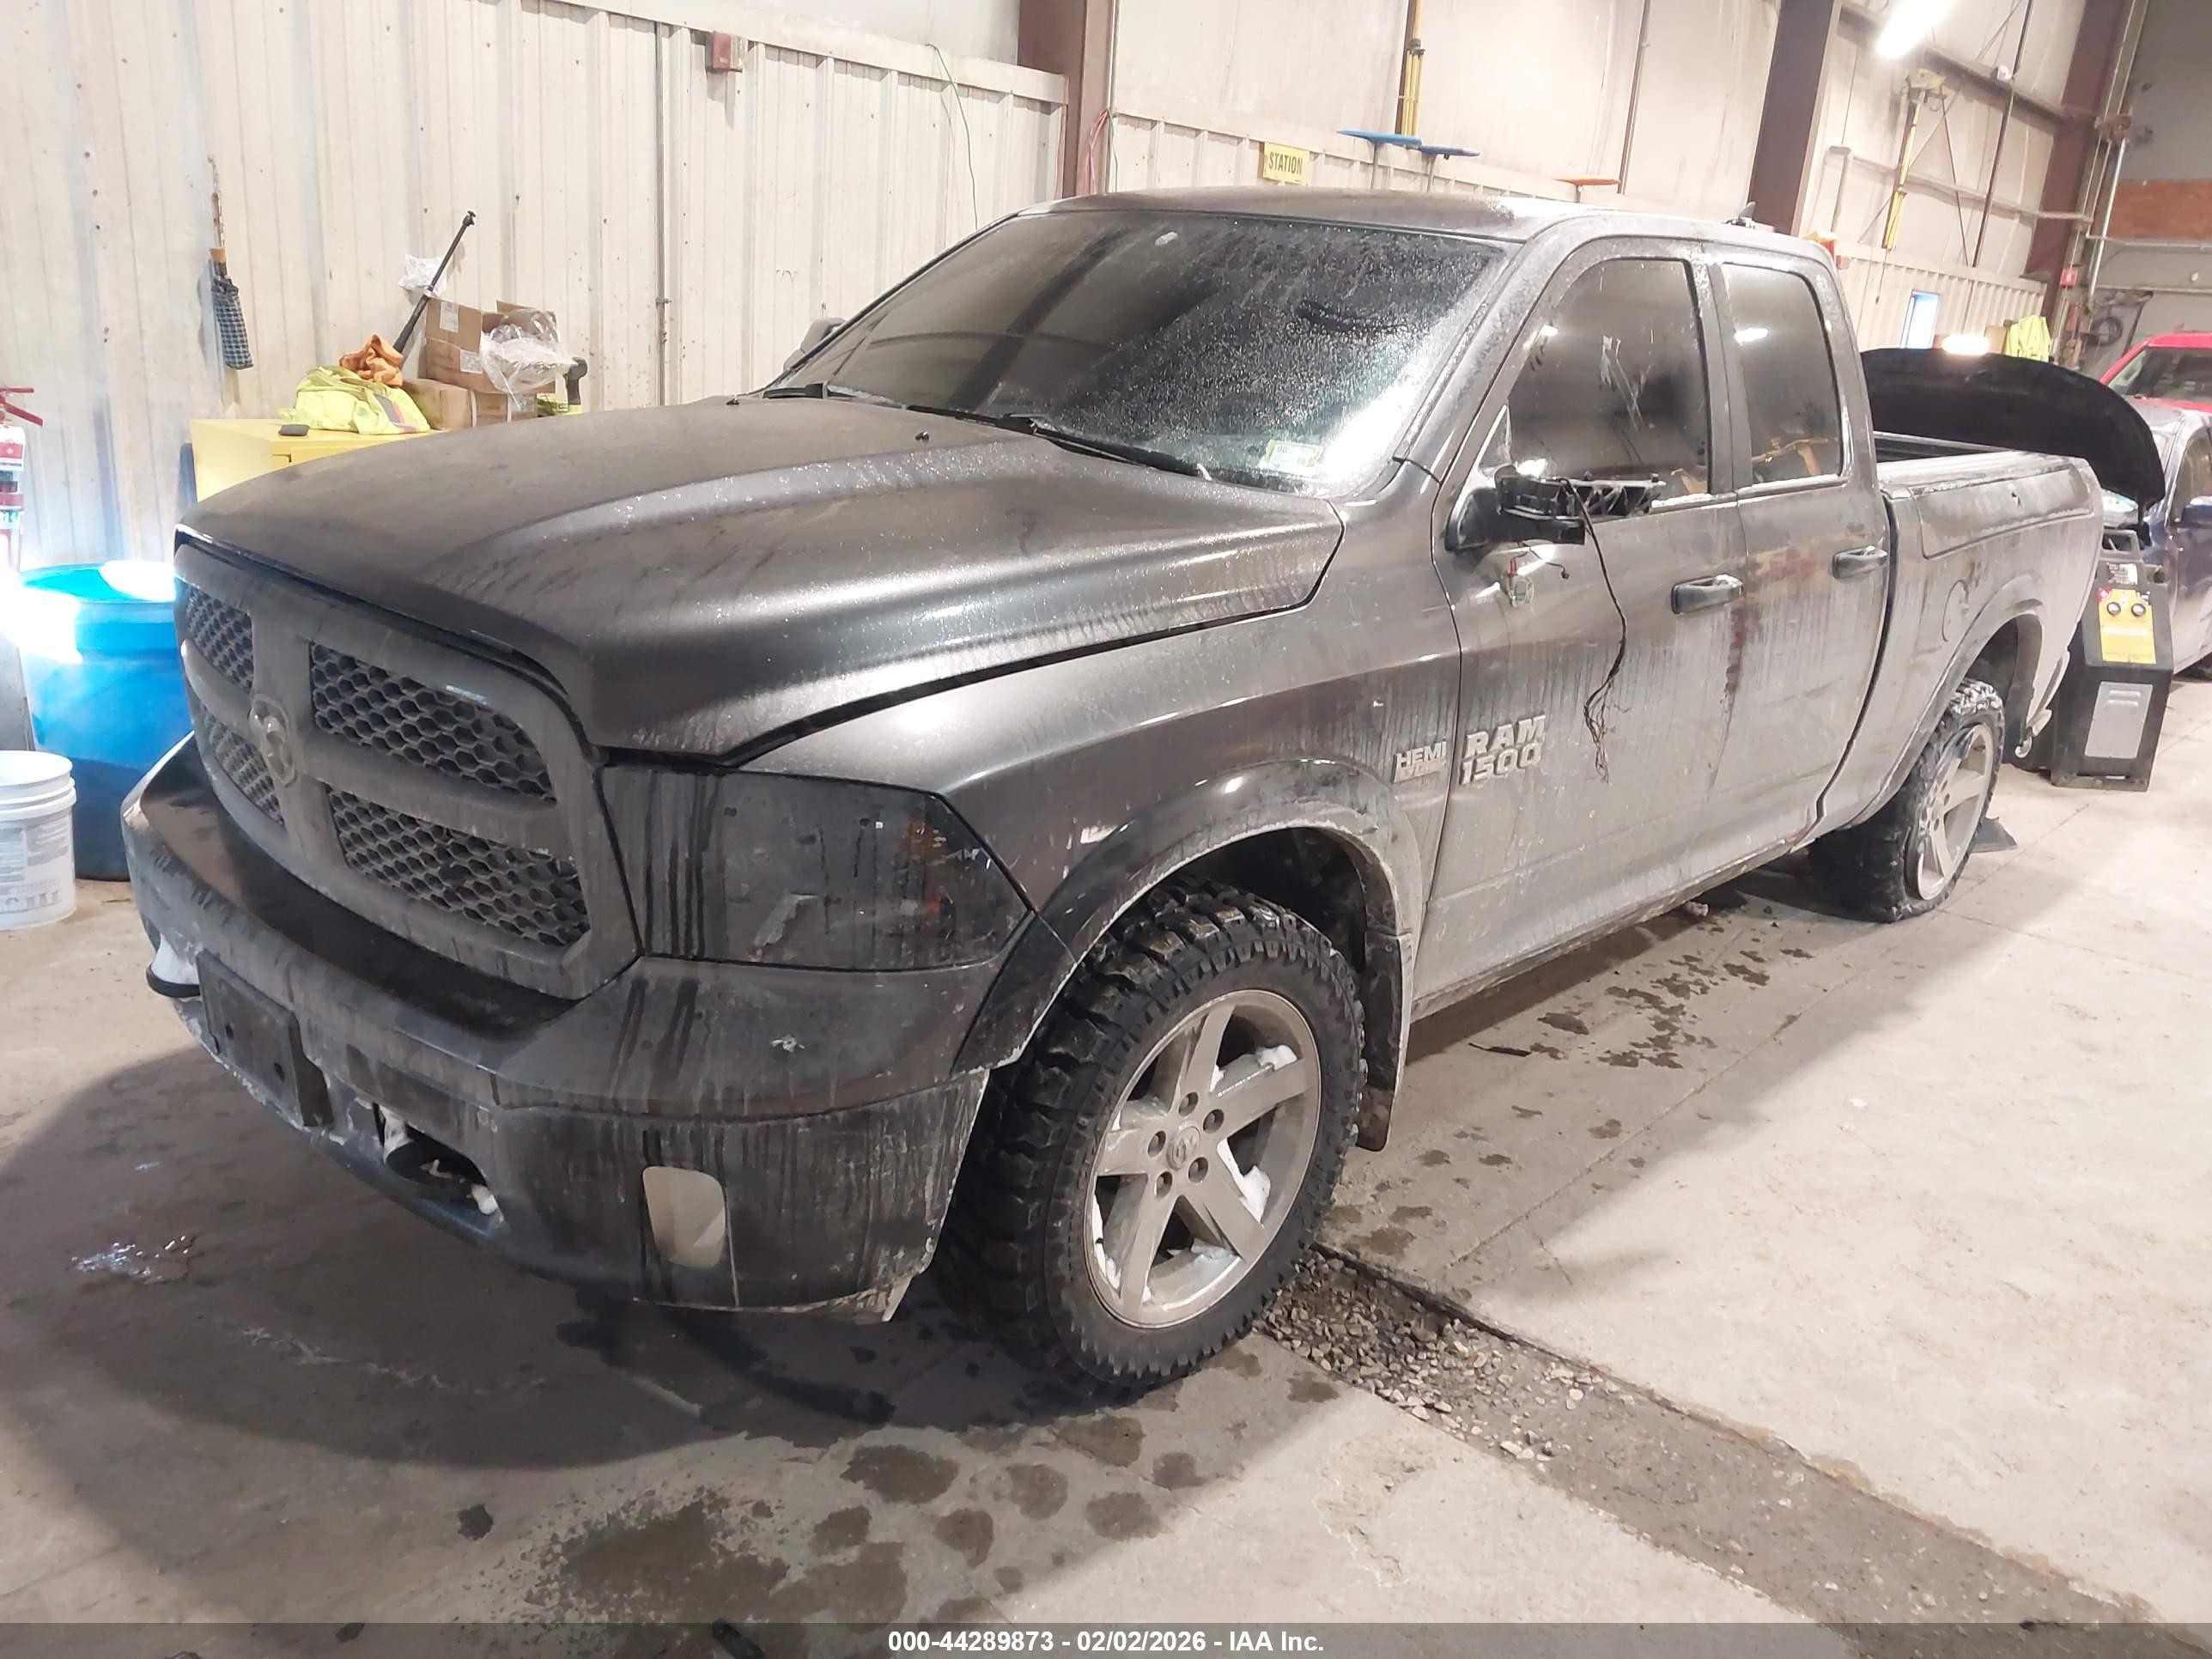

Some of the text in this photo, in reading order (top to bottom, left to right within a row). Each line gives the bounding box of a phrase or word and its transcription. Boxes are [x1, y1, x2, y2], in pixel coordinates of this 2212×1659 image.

[1268, 151, 1304, 175] STATION
[1464, 714, 1546, 758] RAM
[1395, 741, 1447, 768] HEMI
[1462, 743, 1542, 785] 1500
